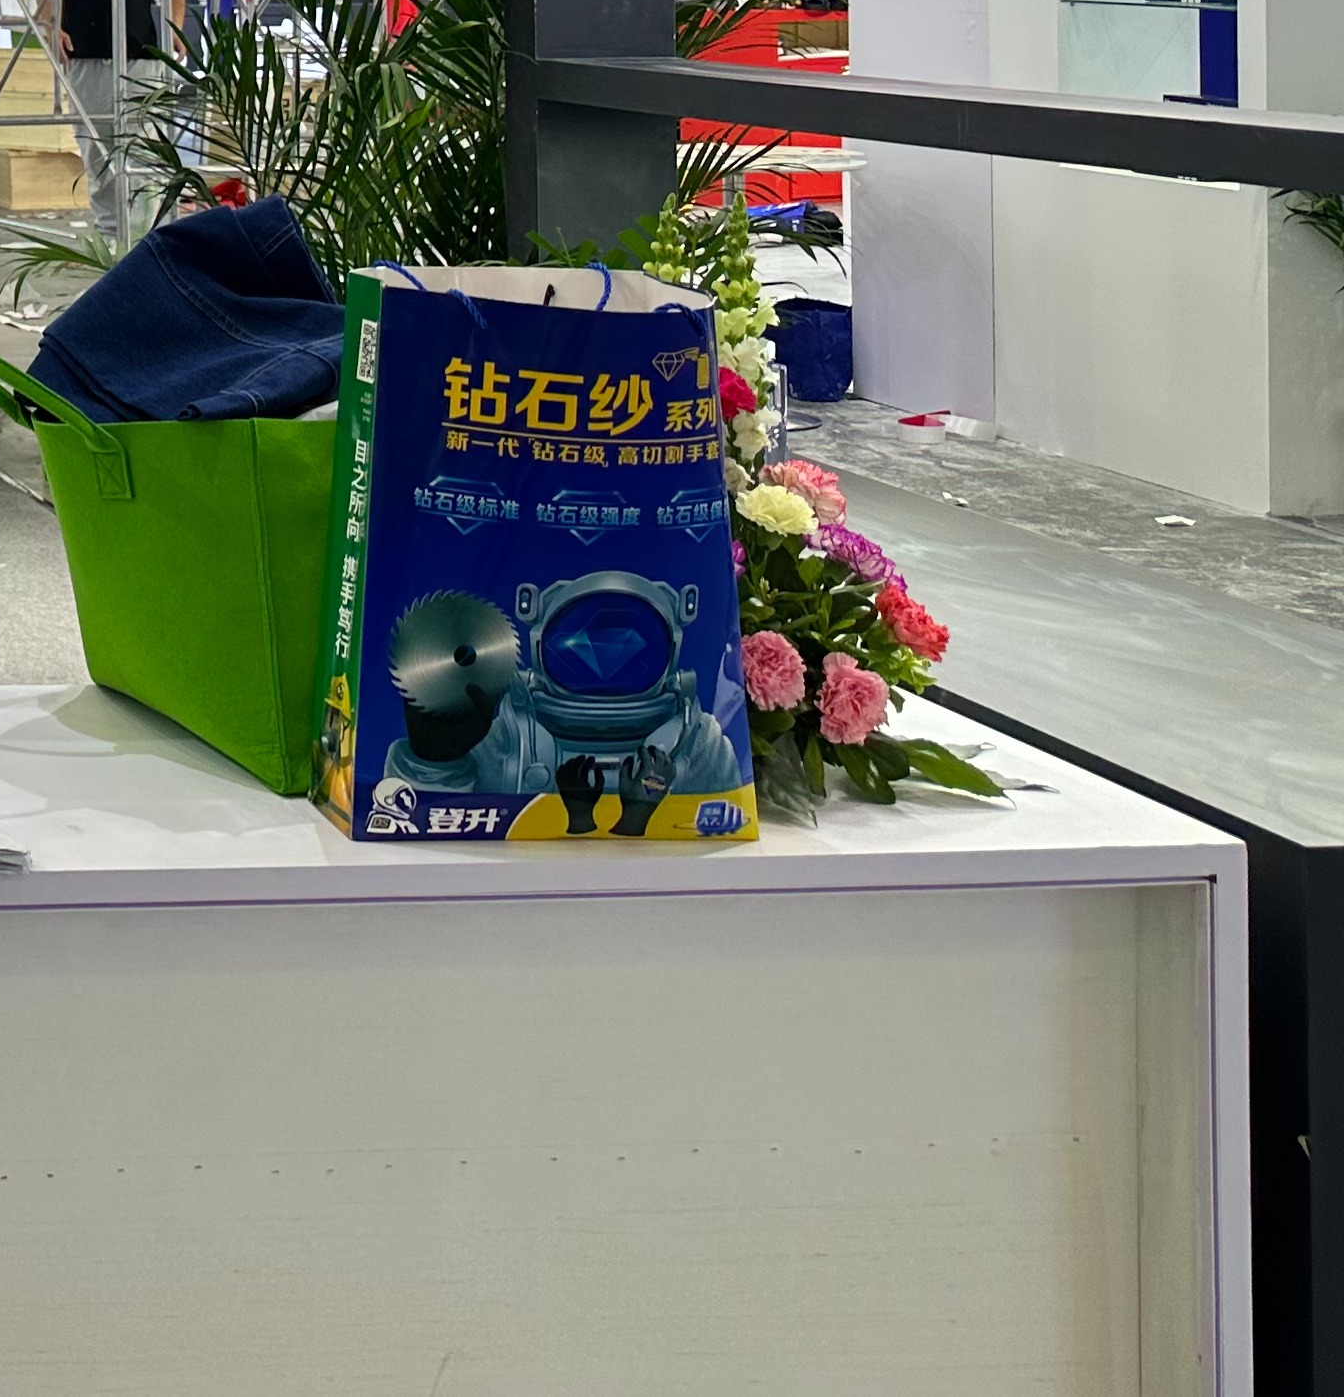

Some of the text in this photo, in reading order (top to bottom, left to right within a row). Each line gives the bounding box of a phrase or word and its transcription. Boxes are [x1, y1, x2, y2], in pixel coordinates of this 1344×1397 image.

[443, 357, 716, 436] 钻石纱 系列
[414, 487, 520, 520] 钻石级标准
[536, 502, 641, 526] 钻石级强度
[426, 808, 500, 834] 登升
